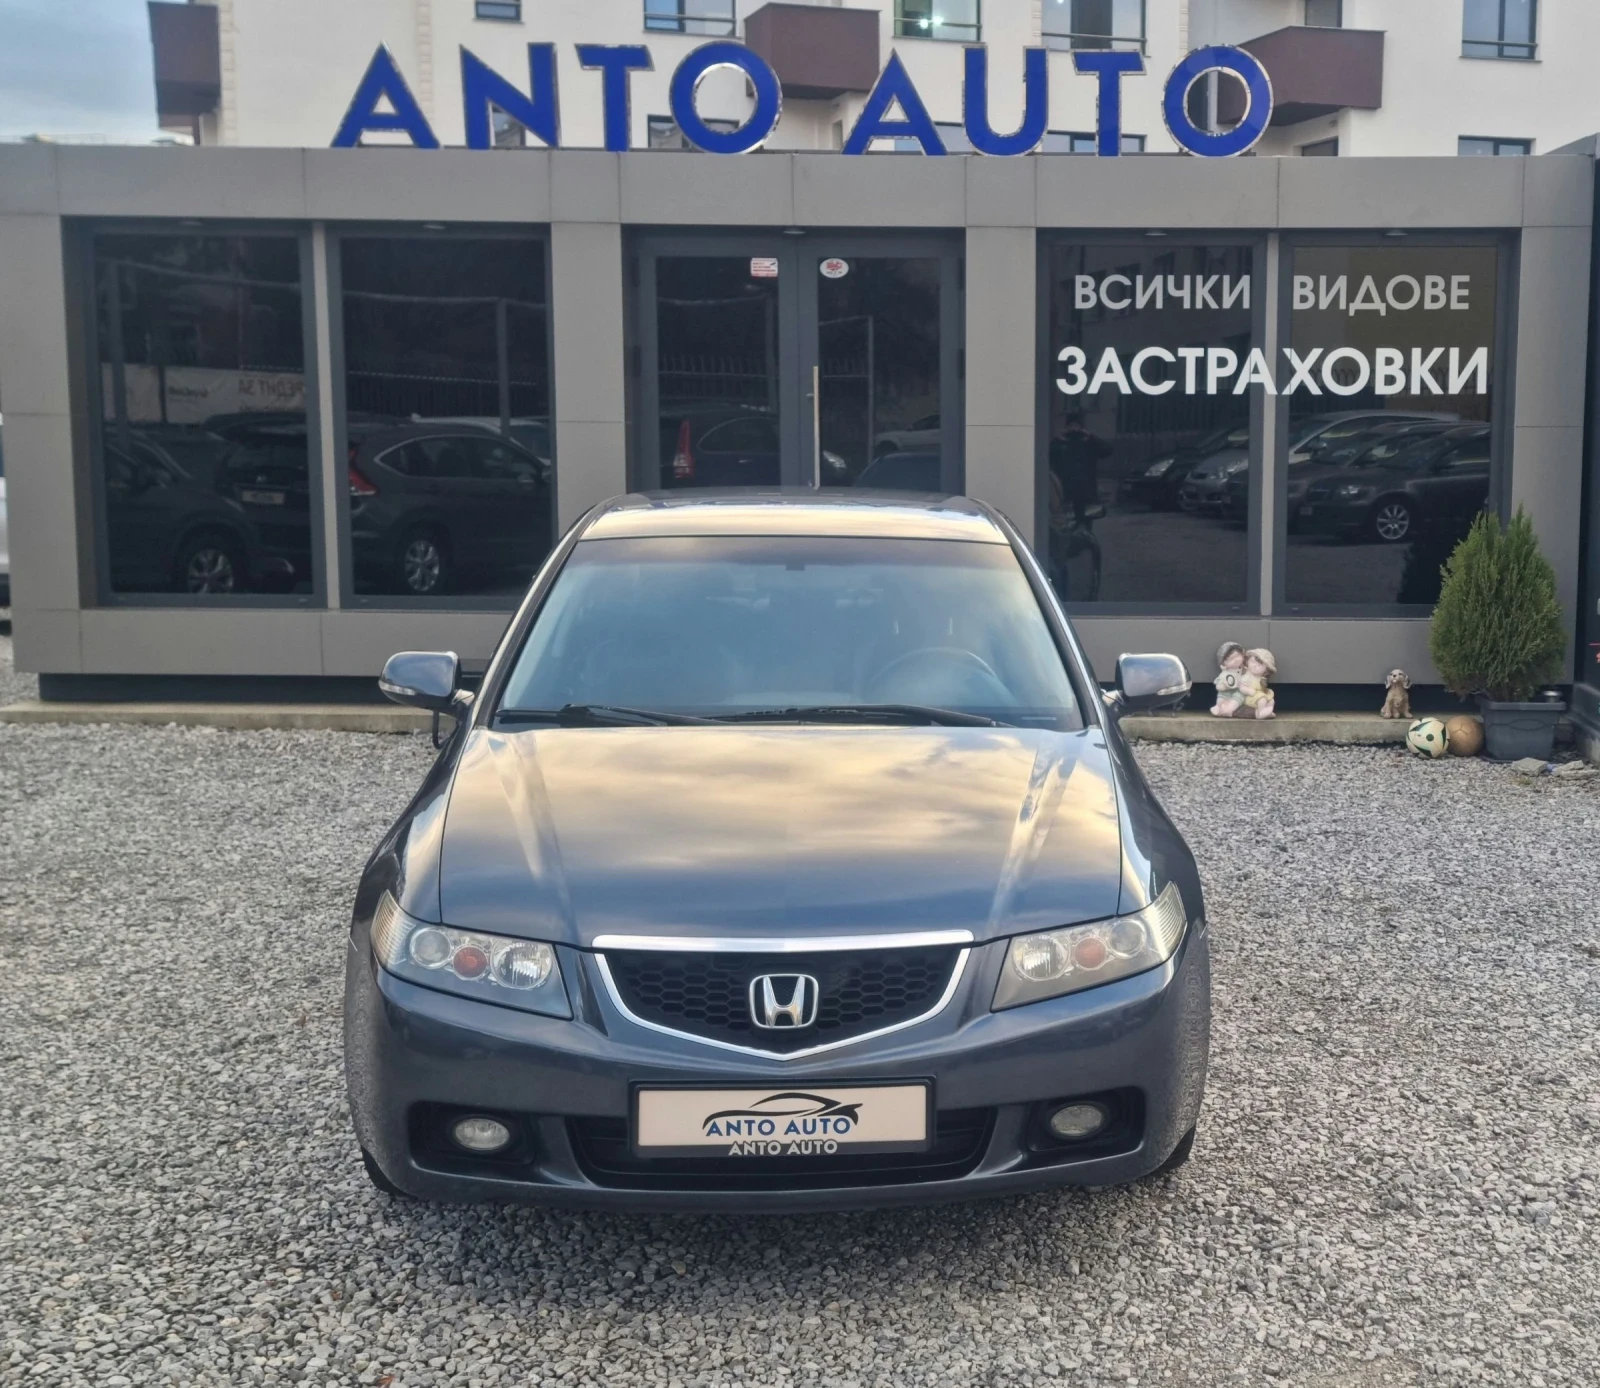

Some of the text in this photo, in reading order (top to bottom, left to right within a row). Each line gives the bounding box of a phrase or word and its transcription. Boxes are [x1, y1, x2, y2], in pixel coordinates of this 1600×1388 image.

[330, 40, 1274, 156] ANTO AUTO
[1074, 274, 1470, 316] ВСИЧКИ ВИДОВЕ
[1056, 346, 1488, 396] ЗАСТРАХОВКИ
[705, 1117, 851, 1137] ANTO AUTO
[728, 1138, 838, 1156] ANTO AUTO
